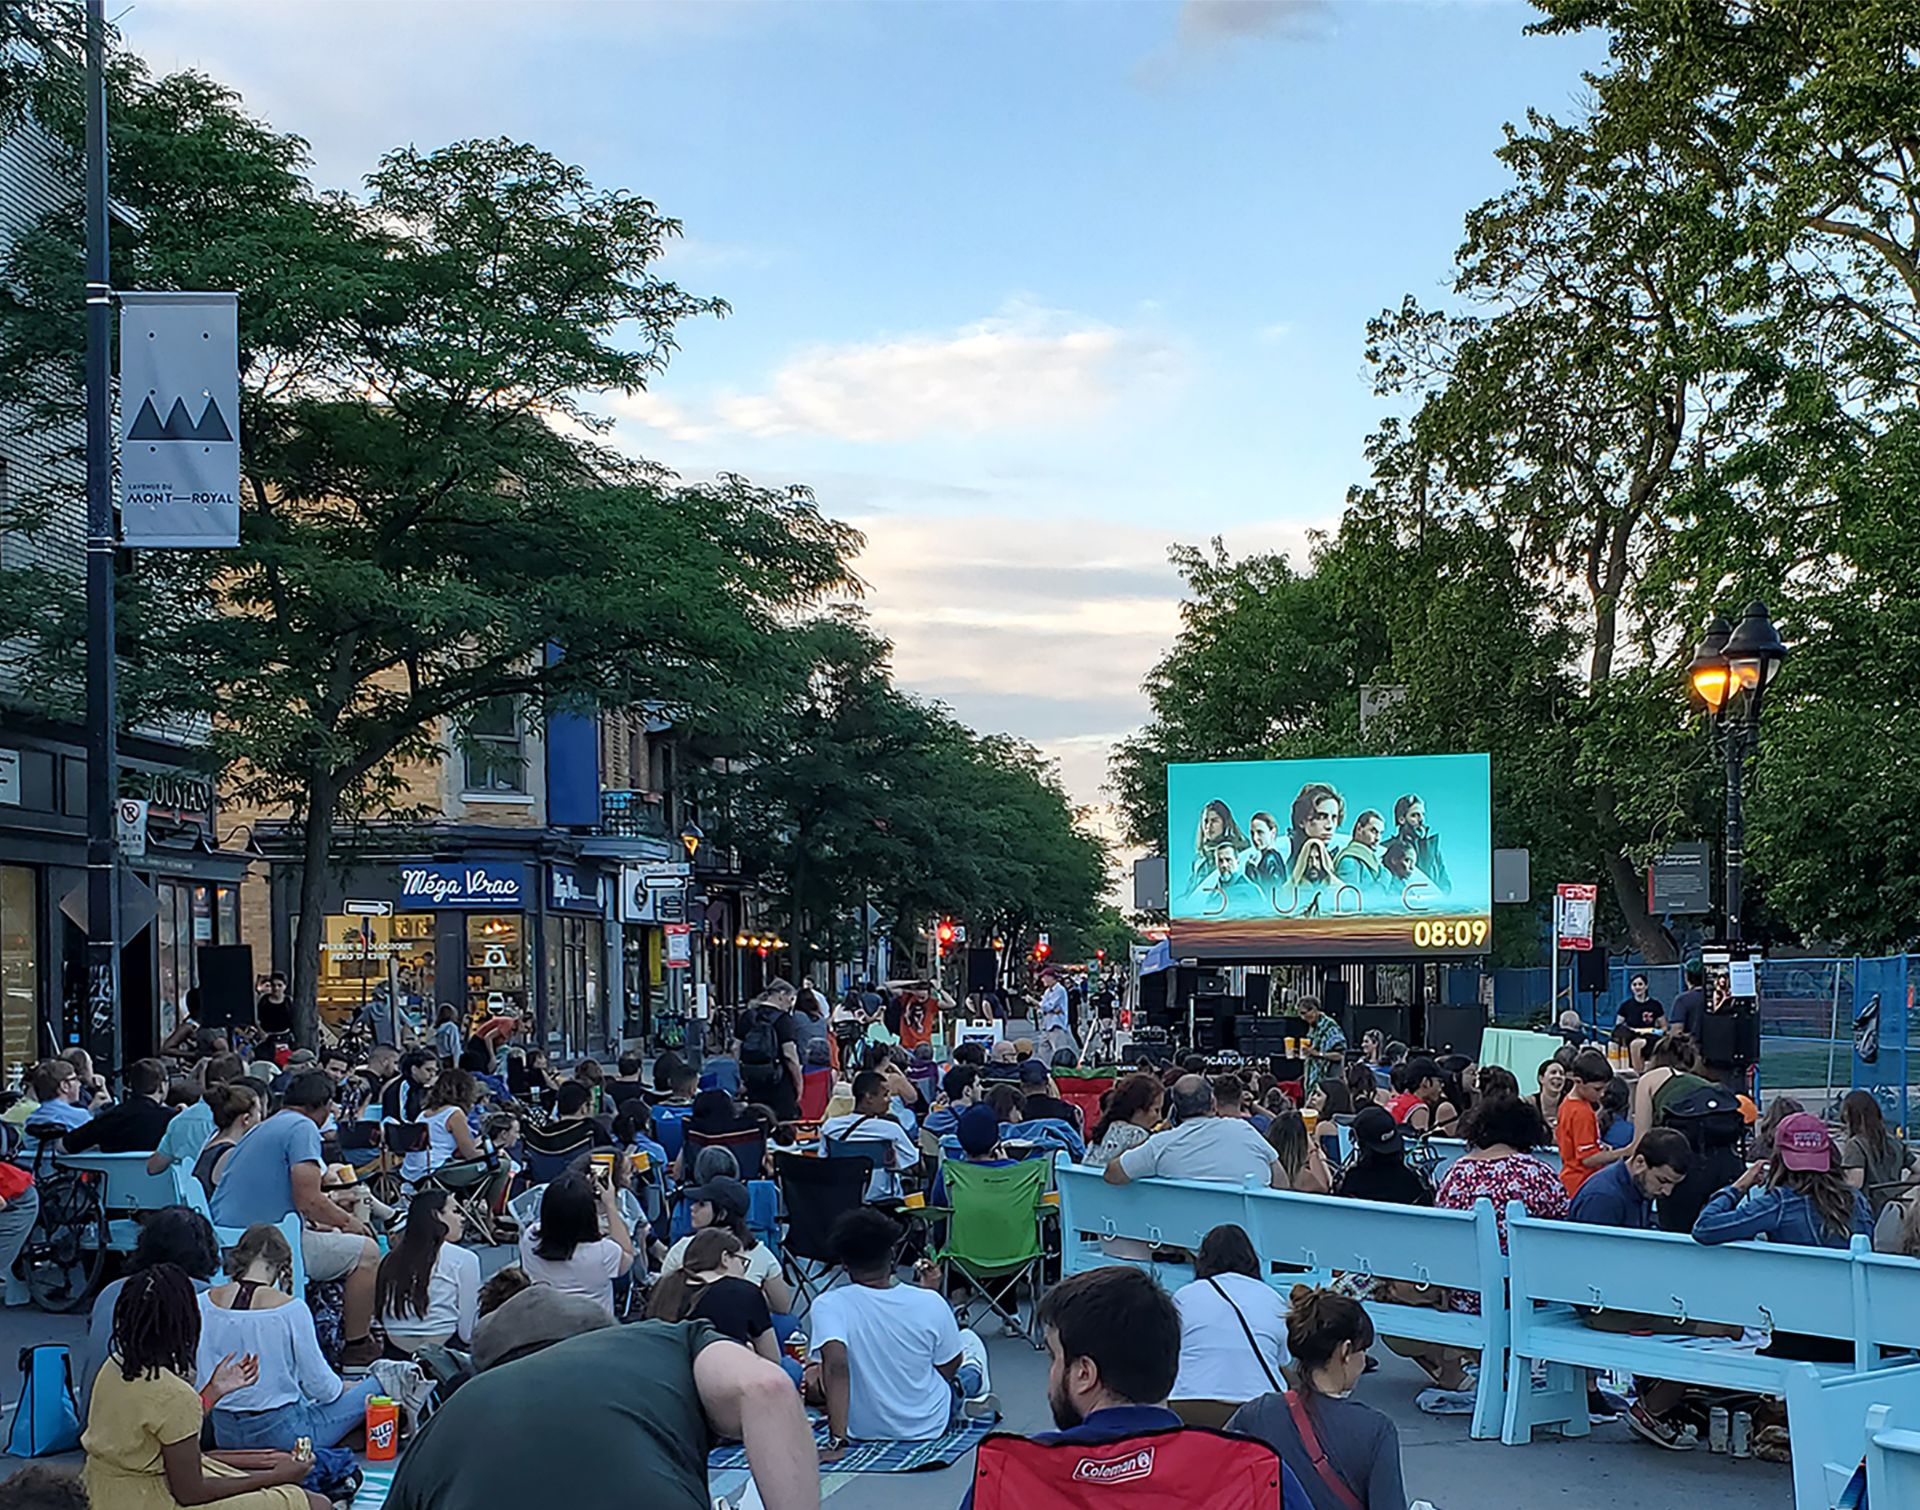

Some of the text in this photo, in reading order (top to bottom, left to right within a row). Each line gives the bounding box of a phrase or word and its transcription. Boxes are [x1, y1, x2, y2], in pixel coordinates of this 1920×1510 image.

[147, 774, 210, 812] OUSTAN
[402, 869, 463, 903] Méga
[465, 869, 520, 895] Vrac
[1202, 883, 1429, 916] DUNE
[1413, 921, 1488, 948] 08:09
[1081, 1457, 1136, 1477] Coleman
